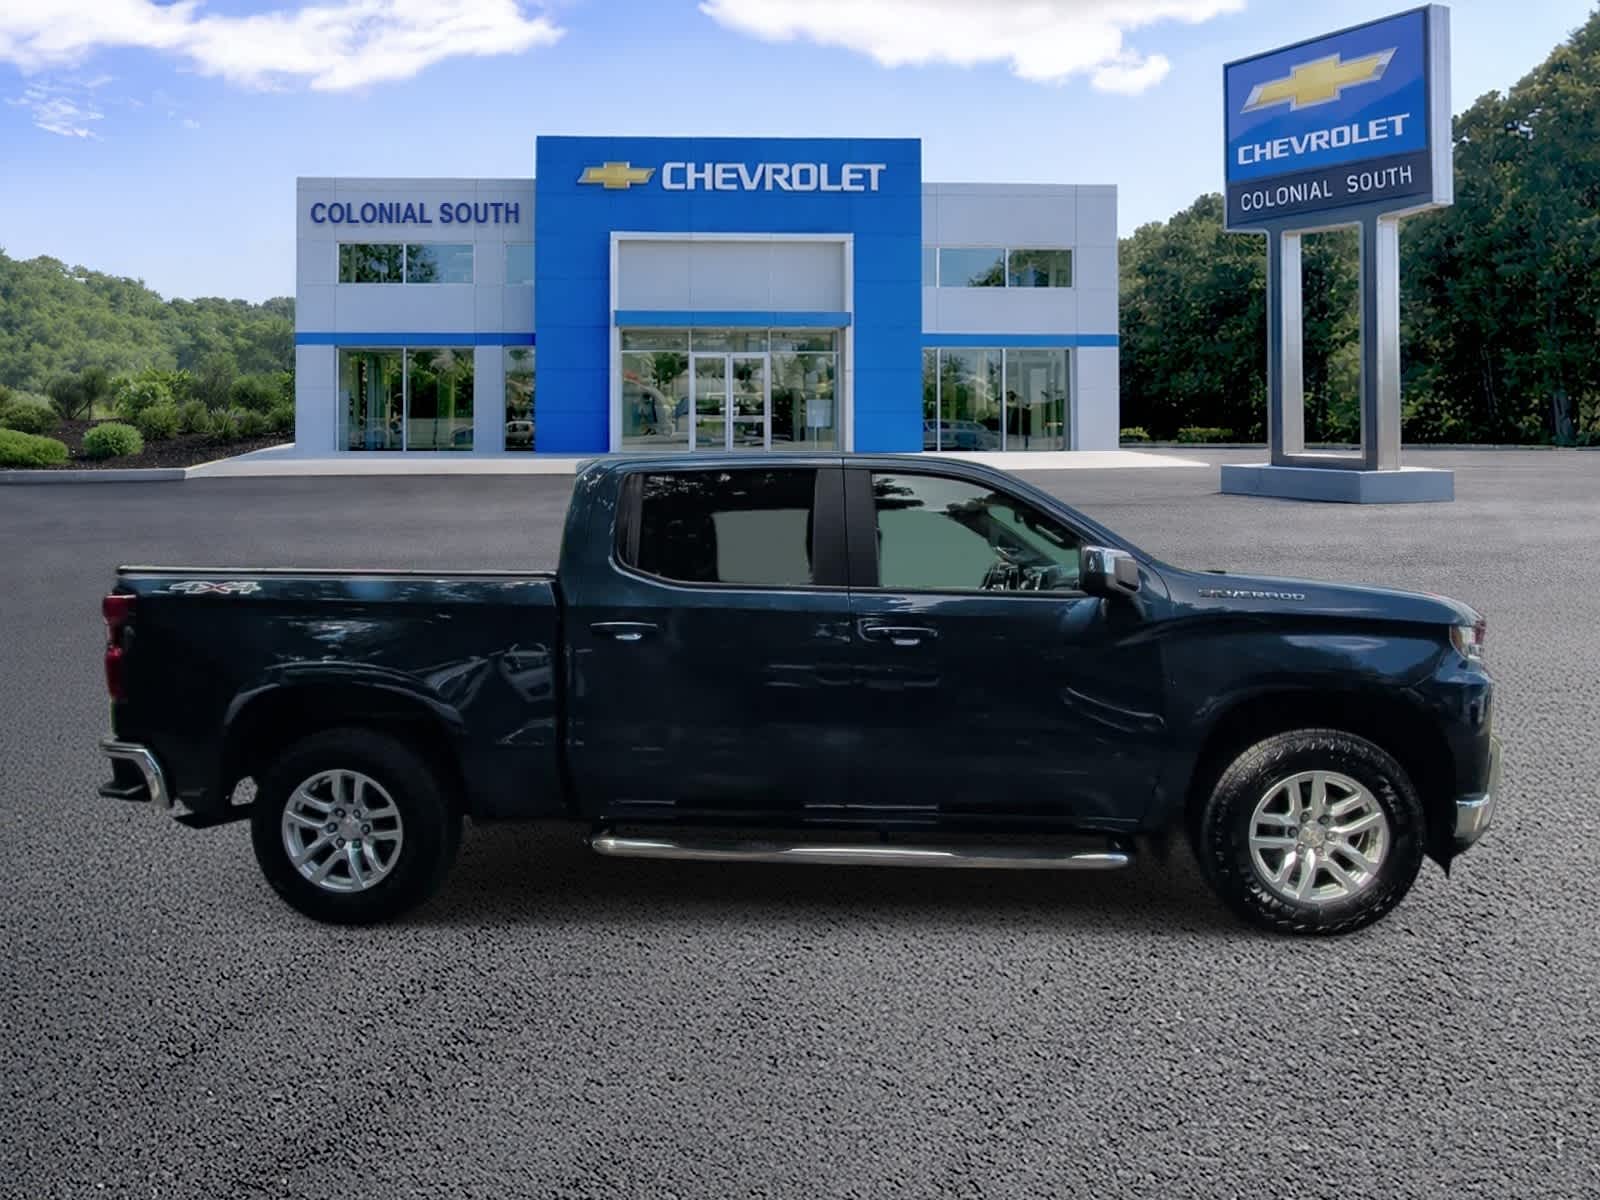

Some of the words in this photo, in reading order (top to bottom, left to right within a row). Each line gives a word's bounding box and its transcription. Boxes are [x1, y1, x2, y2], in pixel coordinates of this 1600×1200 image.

[1238, 113, 1410, 165] CHEVROLET
[662, 162, 887, 192] CHEVROLET
[1241, 181, 1333, 211] COLONIAL
[1347, 165, 1413, 193] SOUTH
[310, 202, 433, 225] COLONIAL
[439, 202, 520, 225] SOUTH
